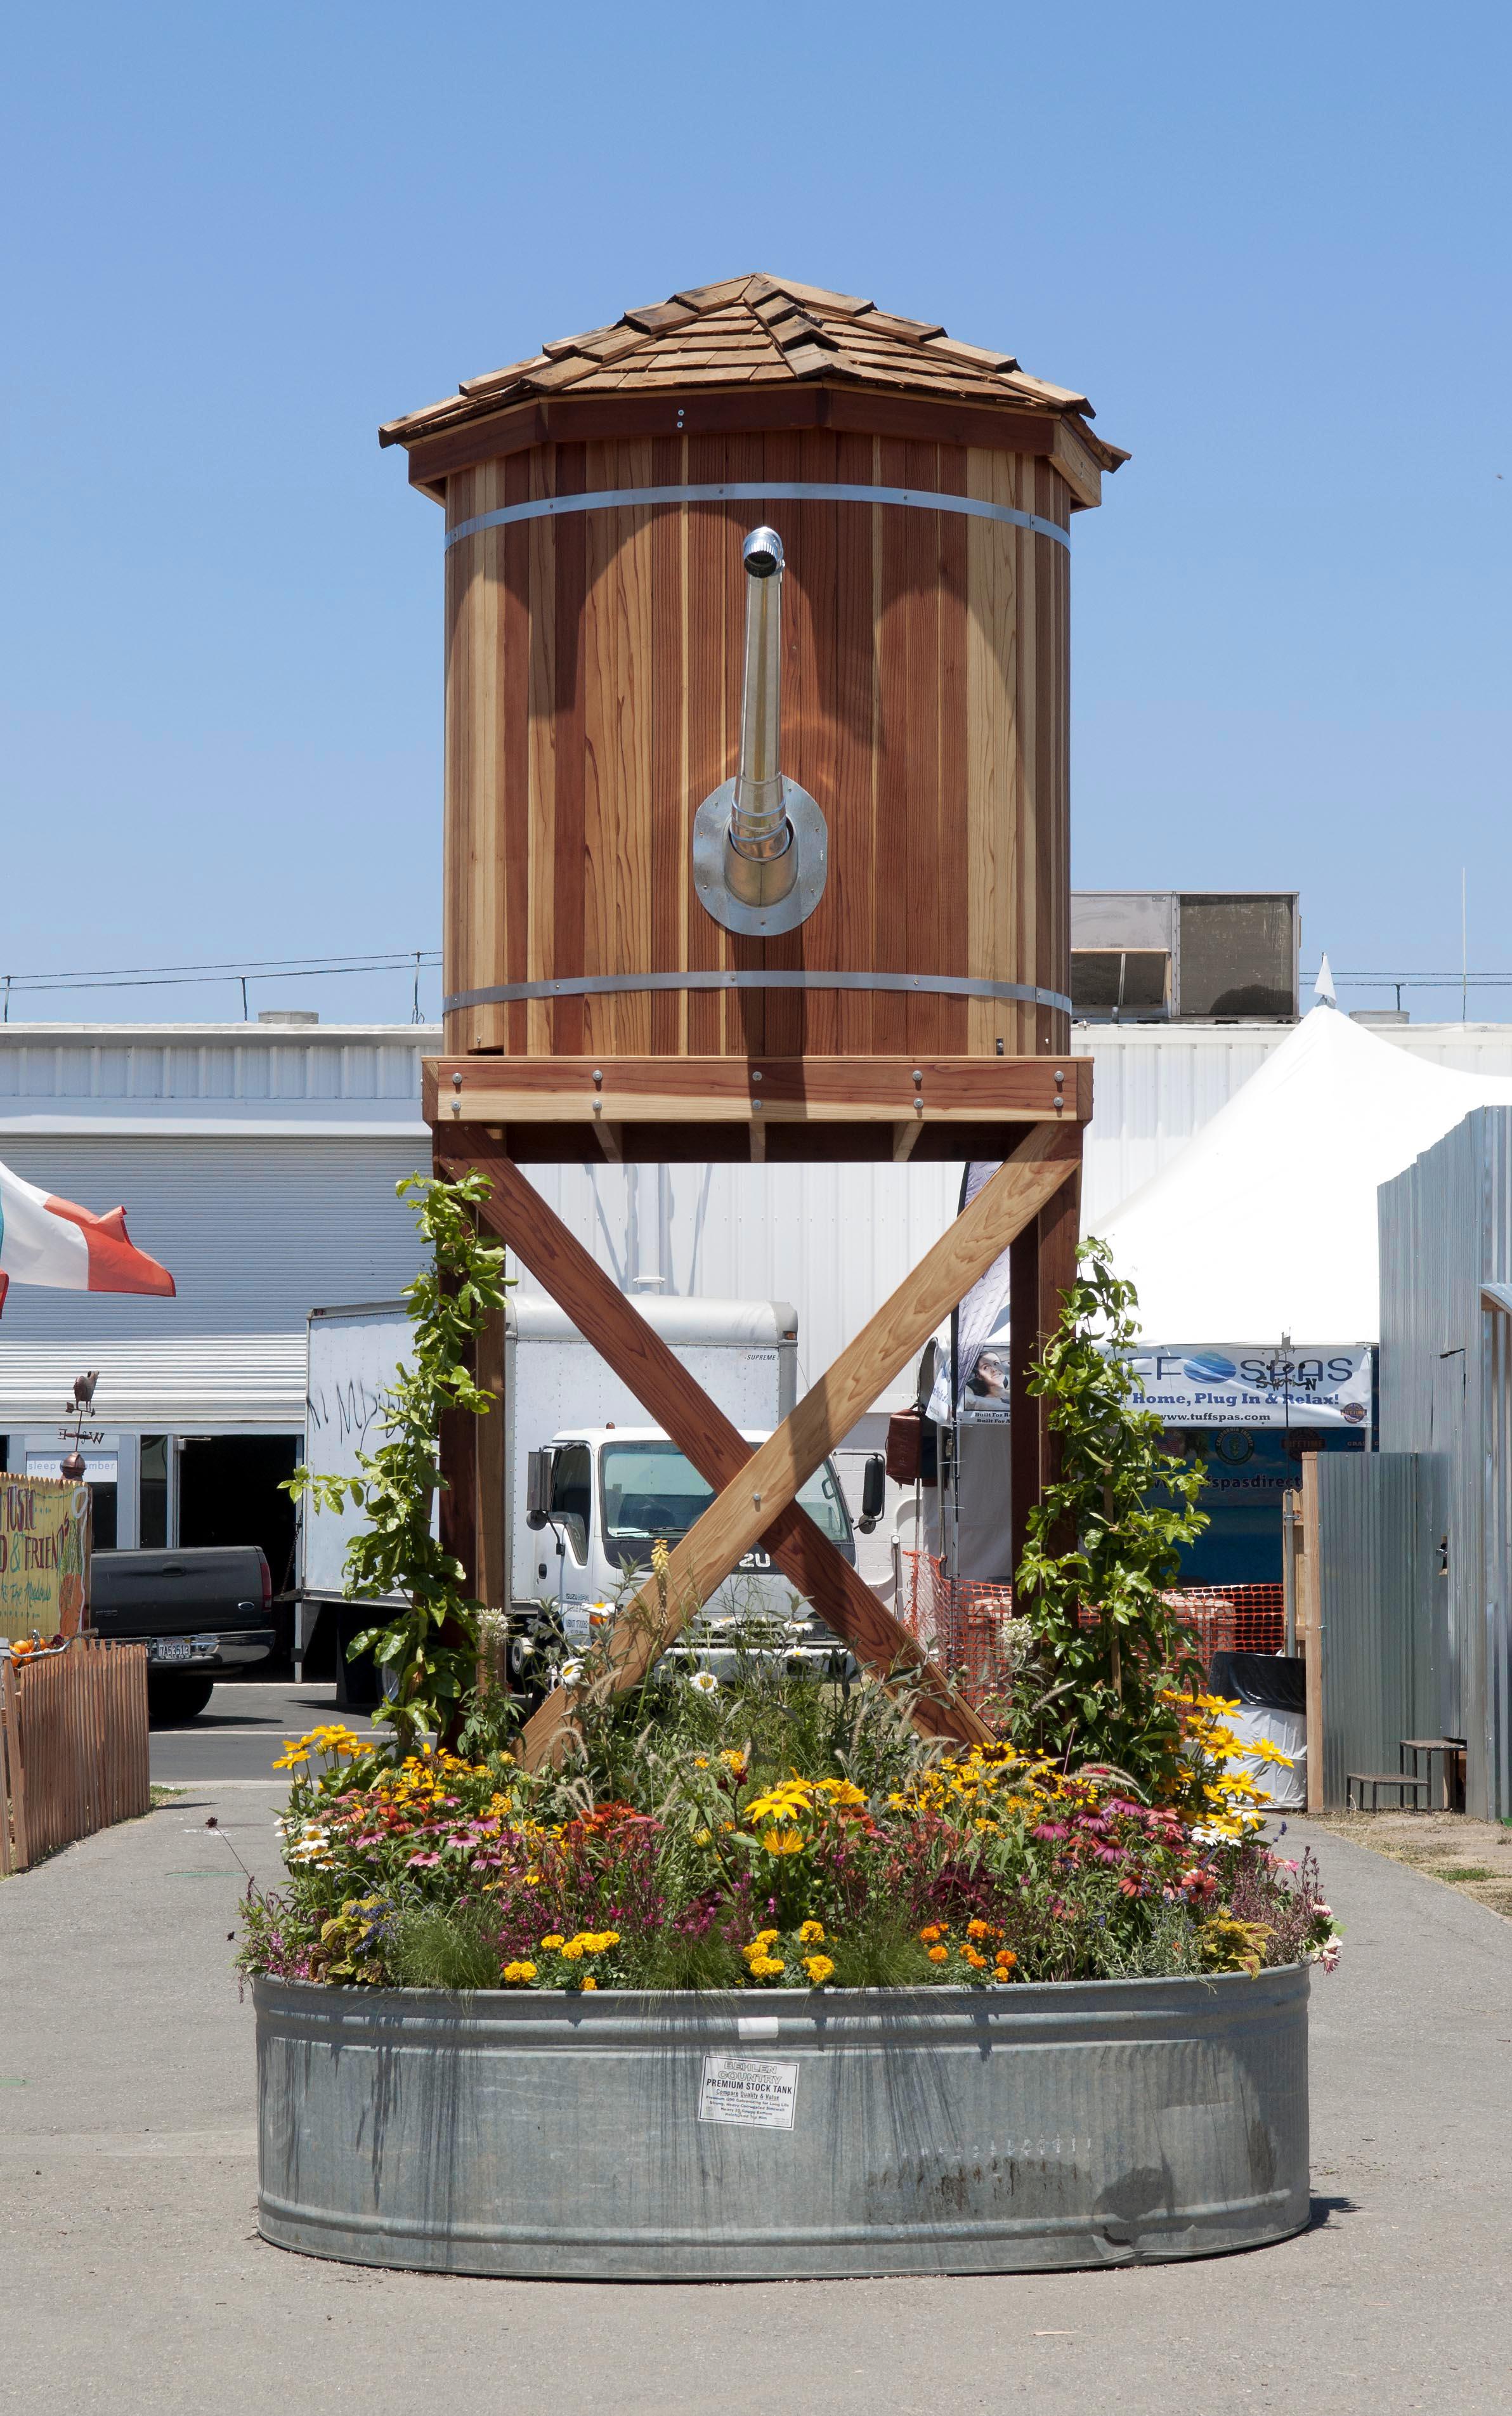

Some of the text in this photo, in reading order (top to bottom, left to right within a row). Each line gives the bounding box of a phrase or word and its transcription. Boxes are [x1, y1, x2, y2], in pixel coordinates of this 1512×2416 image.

[1241, 1357, 1353, 1381] SPAS
[1133, 1393, 1191, 1406] Home,
[1195, 1393, 1237, 1407] Plug
[1242, 1394, 1260, 1404] In
[1265, 1394, 1279, 1404] &
[1282, 1394, 1339, 1404] Relax!
[28, 1461, 115, 1472] sleep mber
[724, 2061, 777, 2074] BEHLEN
[718, 2070, 782, 2085] COUNTRY
[707, 2079, 792, 2094] PREMIUM STOCK TANK
[716, 2089, 738, 2097] Compare
